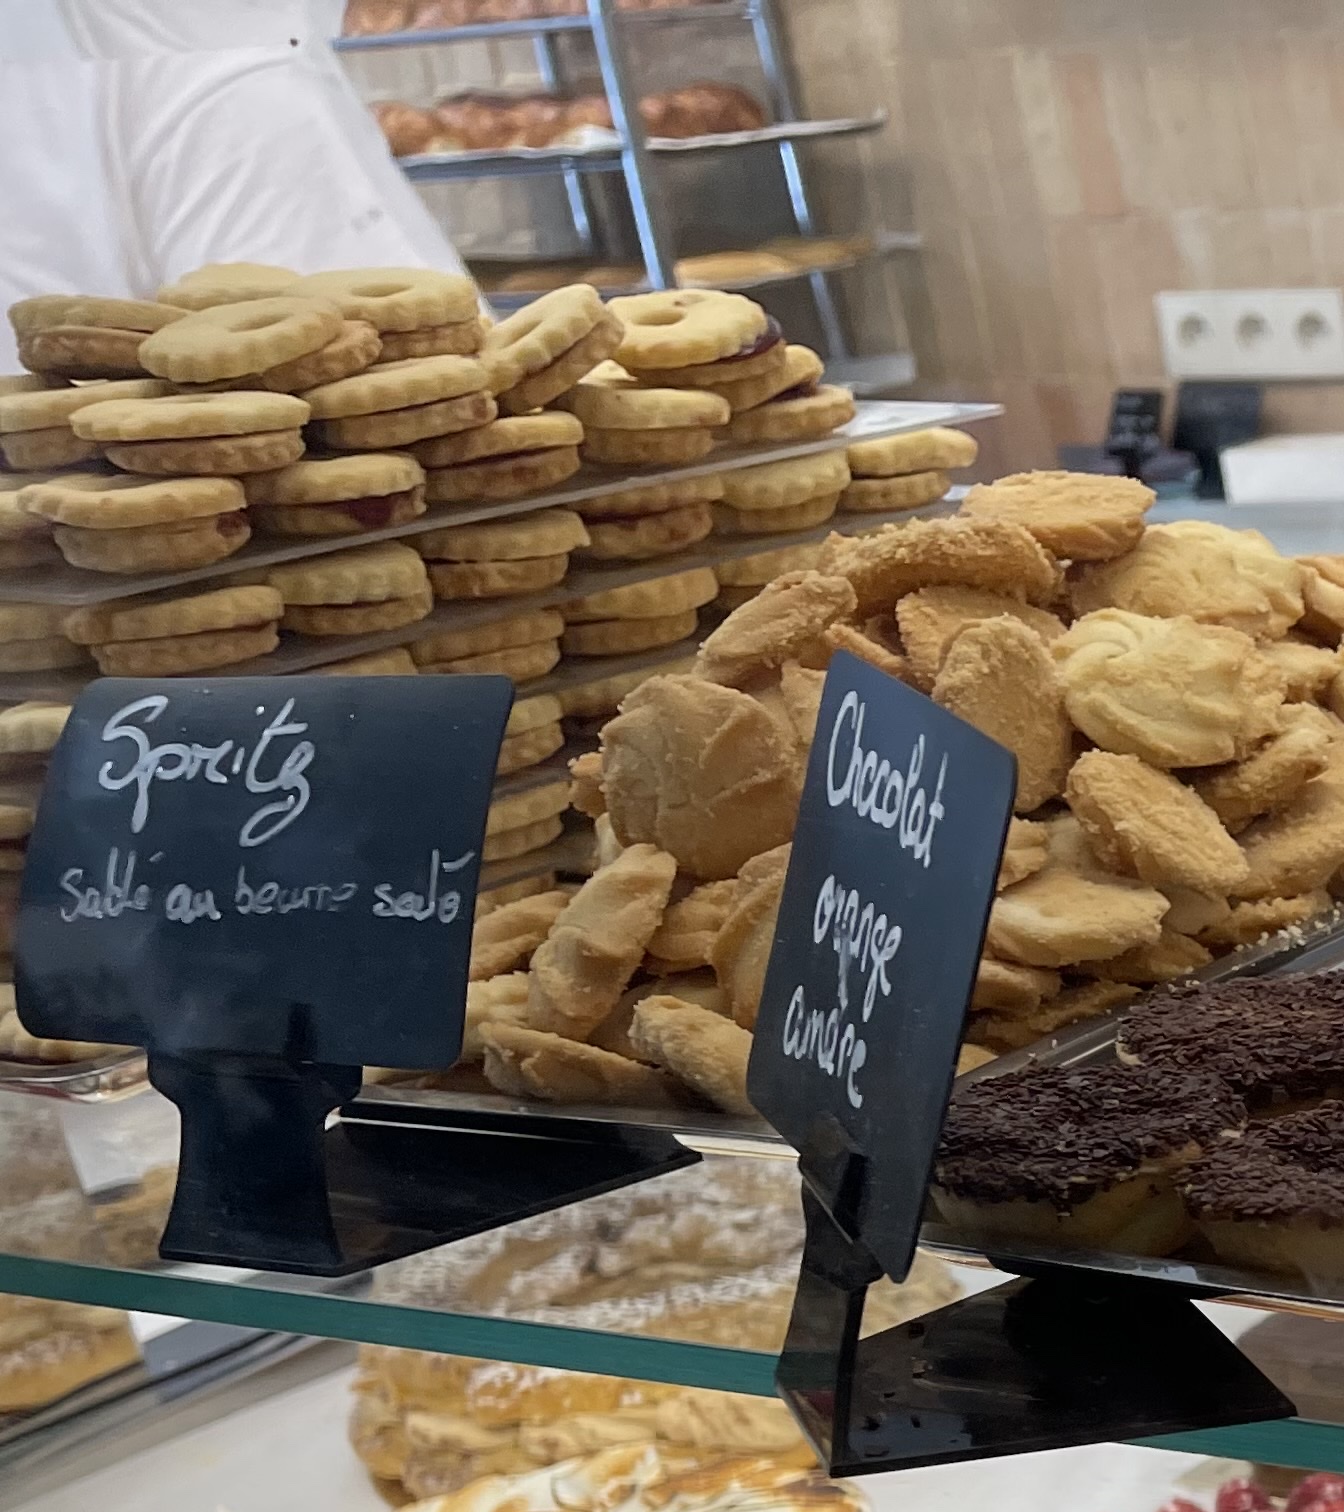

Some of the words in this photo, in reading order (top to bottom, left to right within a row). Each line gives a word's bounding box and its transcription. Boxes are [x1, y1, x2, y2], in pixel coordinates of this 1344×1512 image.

[166, 881, 223, 924] au
[236, 863, 360, 916] beurre
[372, 848, 477, 923] salé
